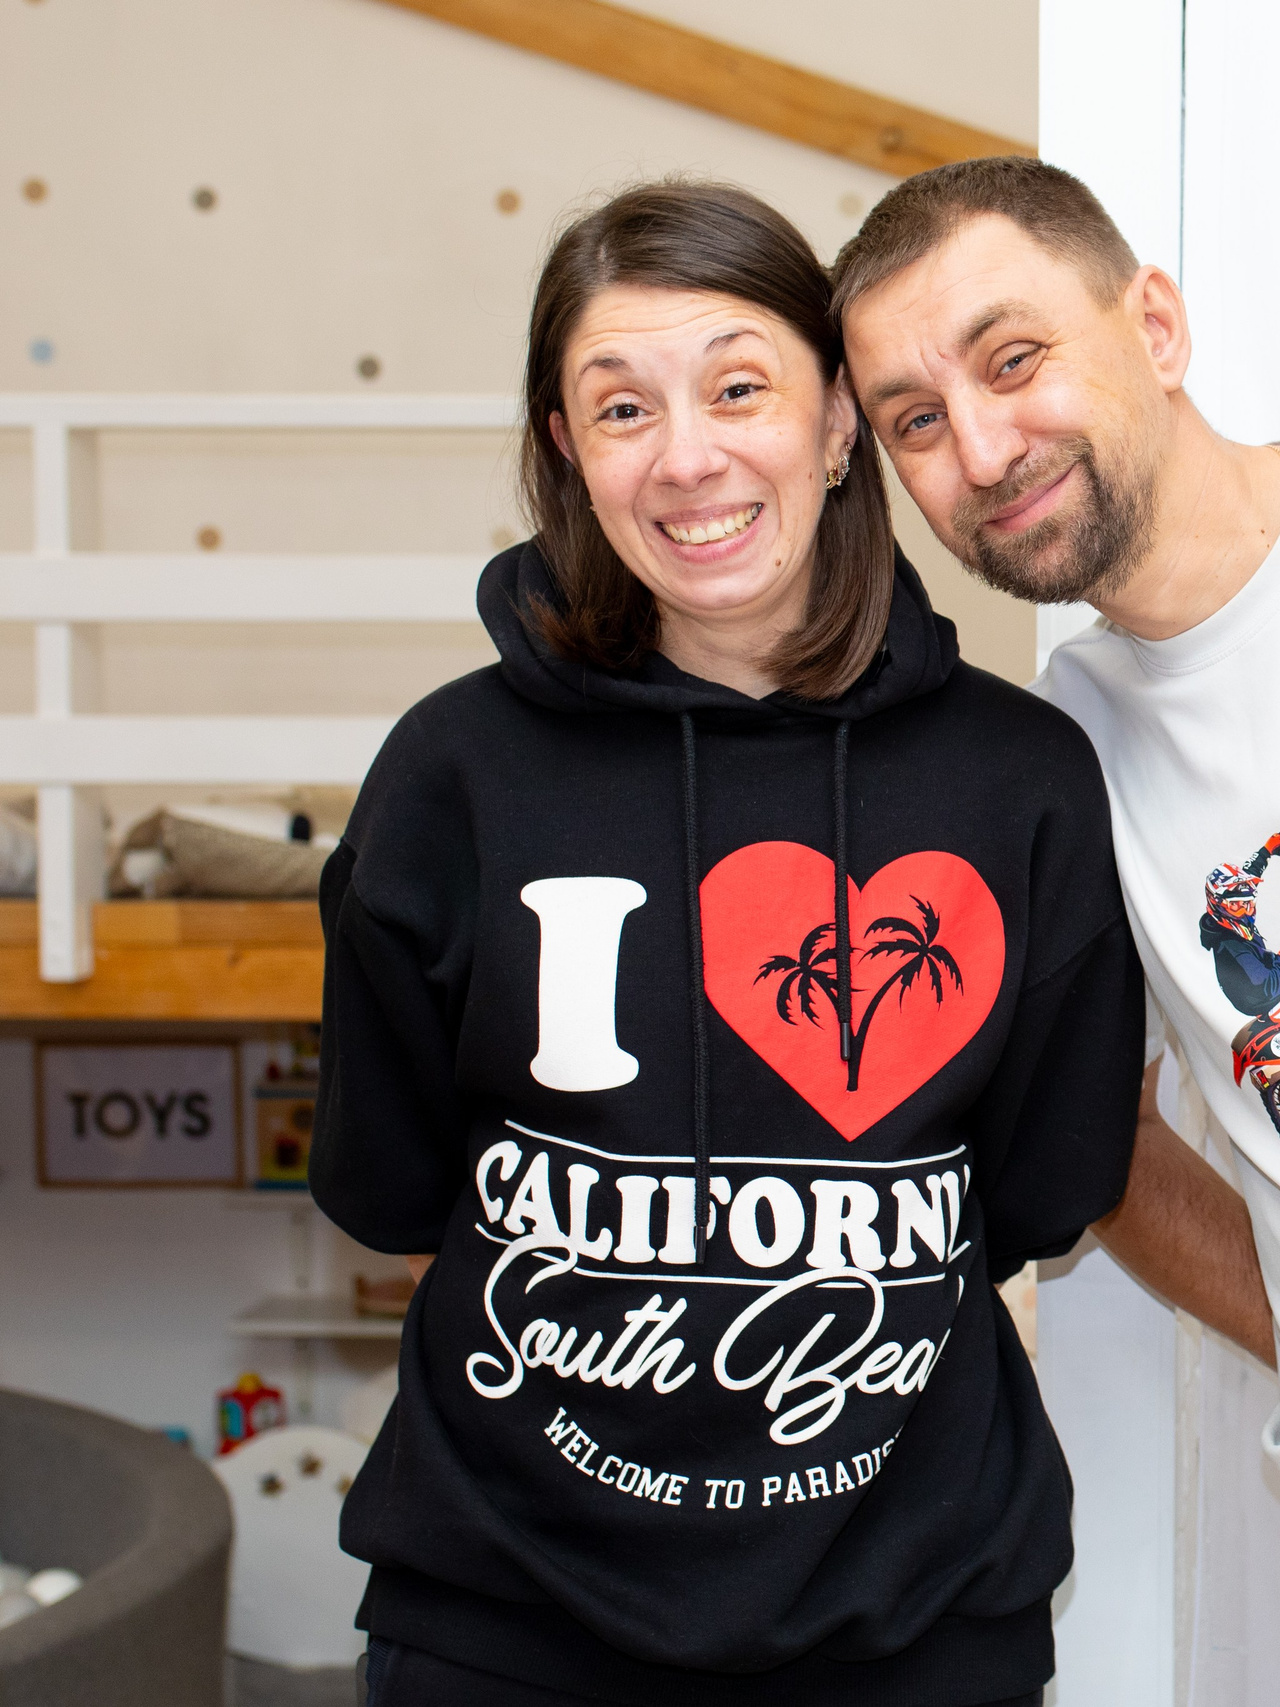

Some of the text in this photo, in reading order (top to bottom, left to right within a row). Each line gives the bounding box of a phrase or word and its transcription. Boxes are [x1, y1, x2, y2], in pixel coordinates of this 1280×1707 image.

[520, 876, 648, 1093] I
[66, 1088, 213, 1141] TOYS
[466, 1232, 697, 1400] South
[543, 1406, 690, 1506] WELCOME
[704, 1479, 746, 1509] TO
